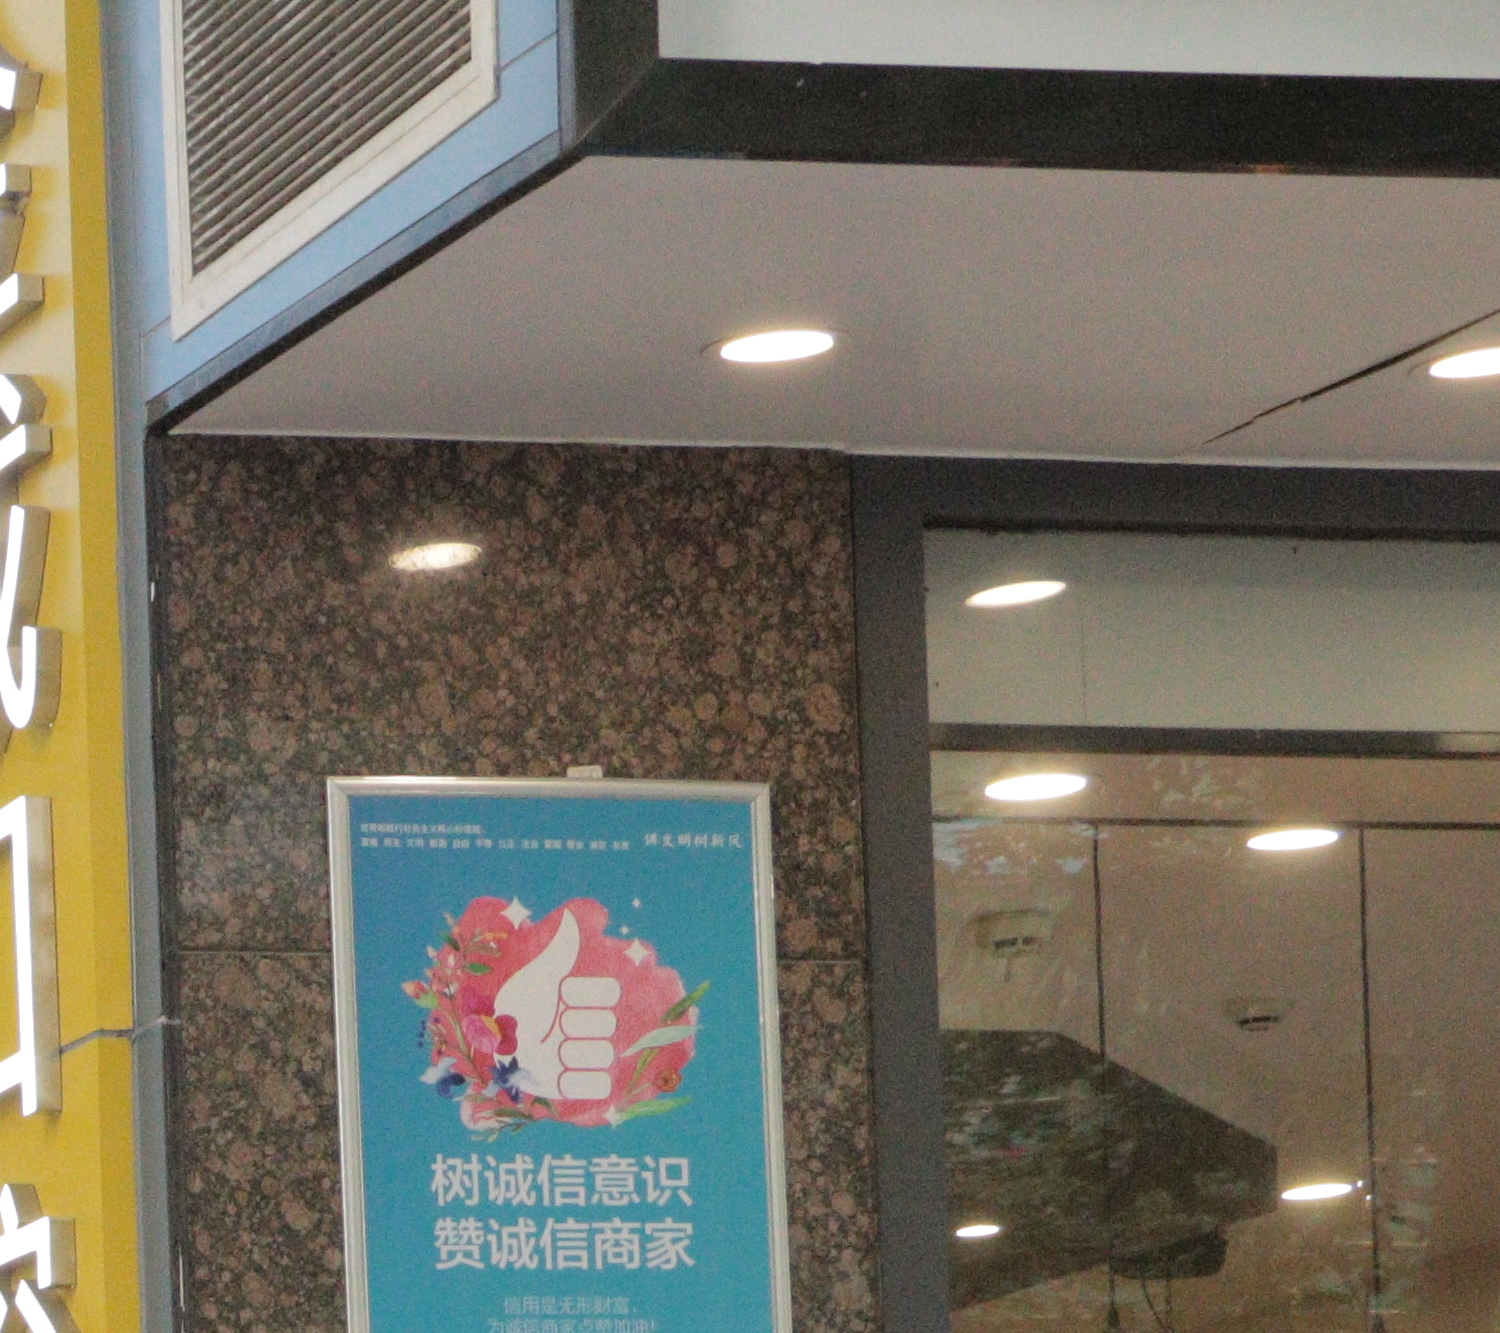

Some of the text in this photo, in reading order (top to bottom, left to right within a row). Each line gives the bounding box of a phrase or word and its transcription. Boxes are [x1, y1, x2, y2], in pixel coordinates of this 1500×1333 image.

[431, 1154, 693, 1206] 树诚信意识
[434, 1217, 695, 1270] 赞诚信商家
